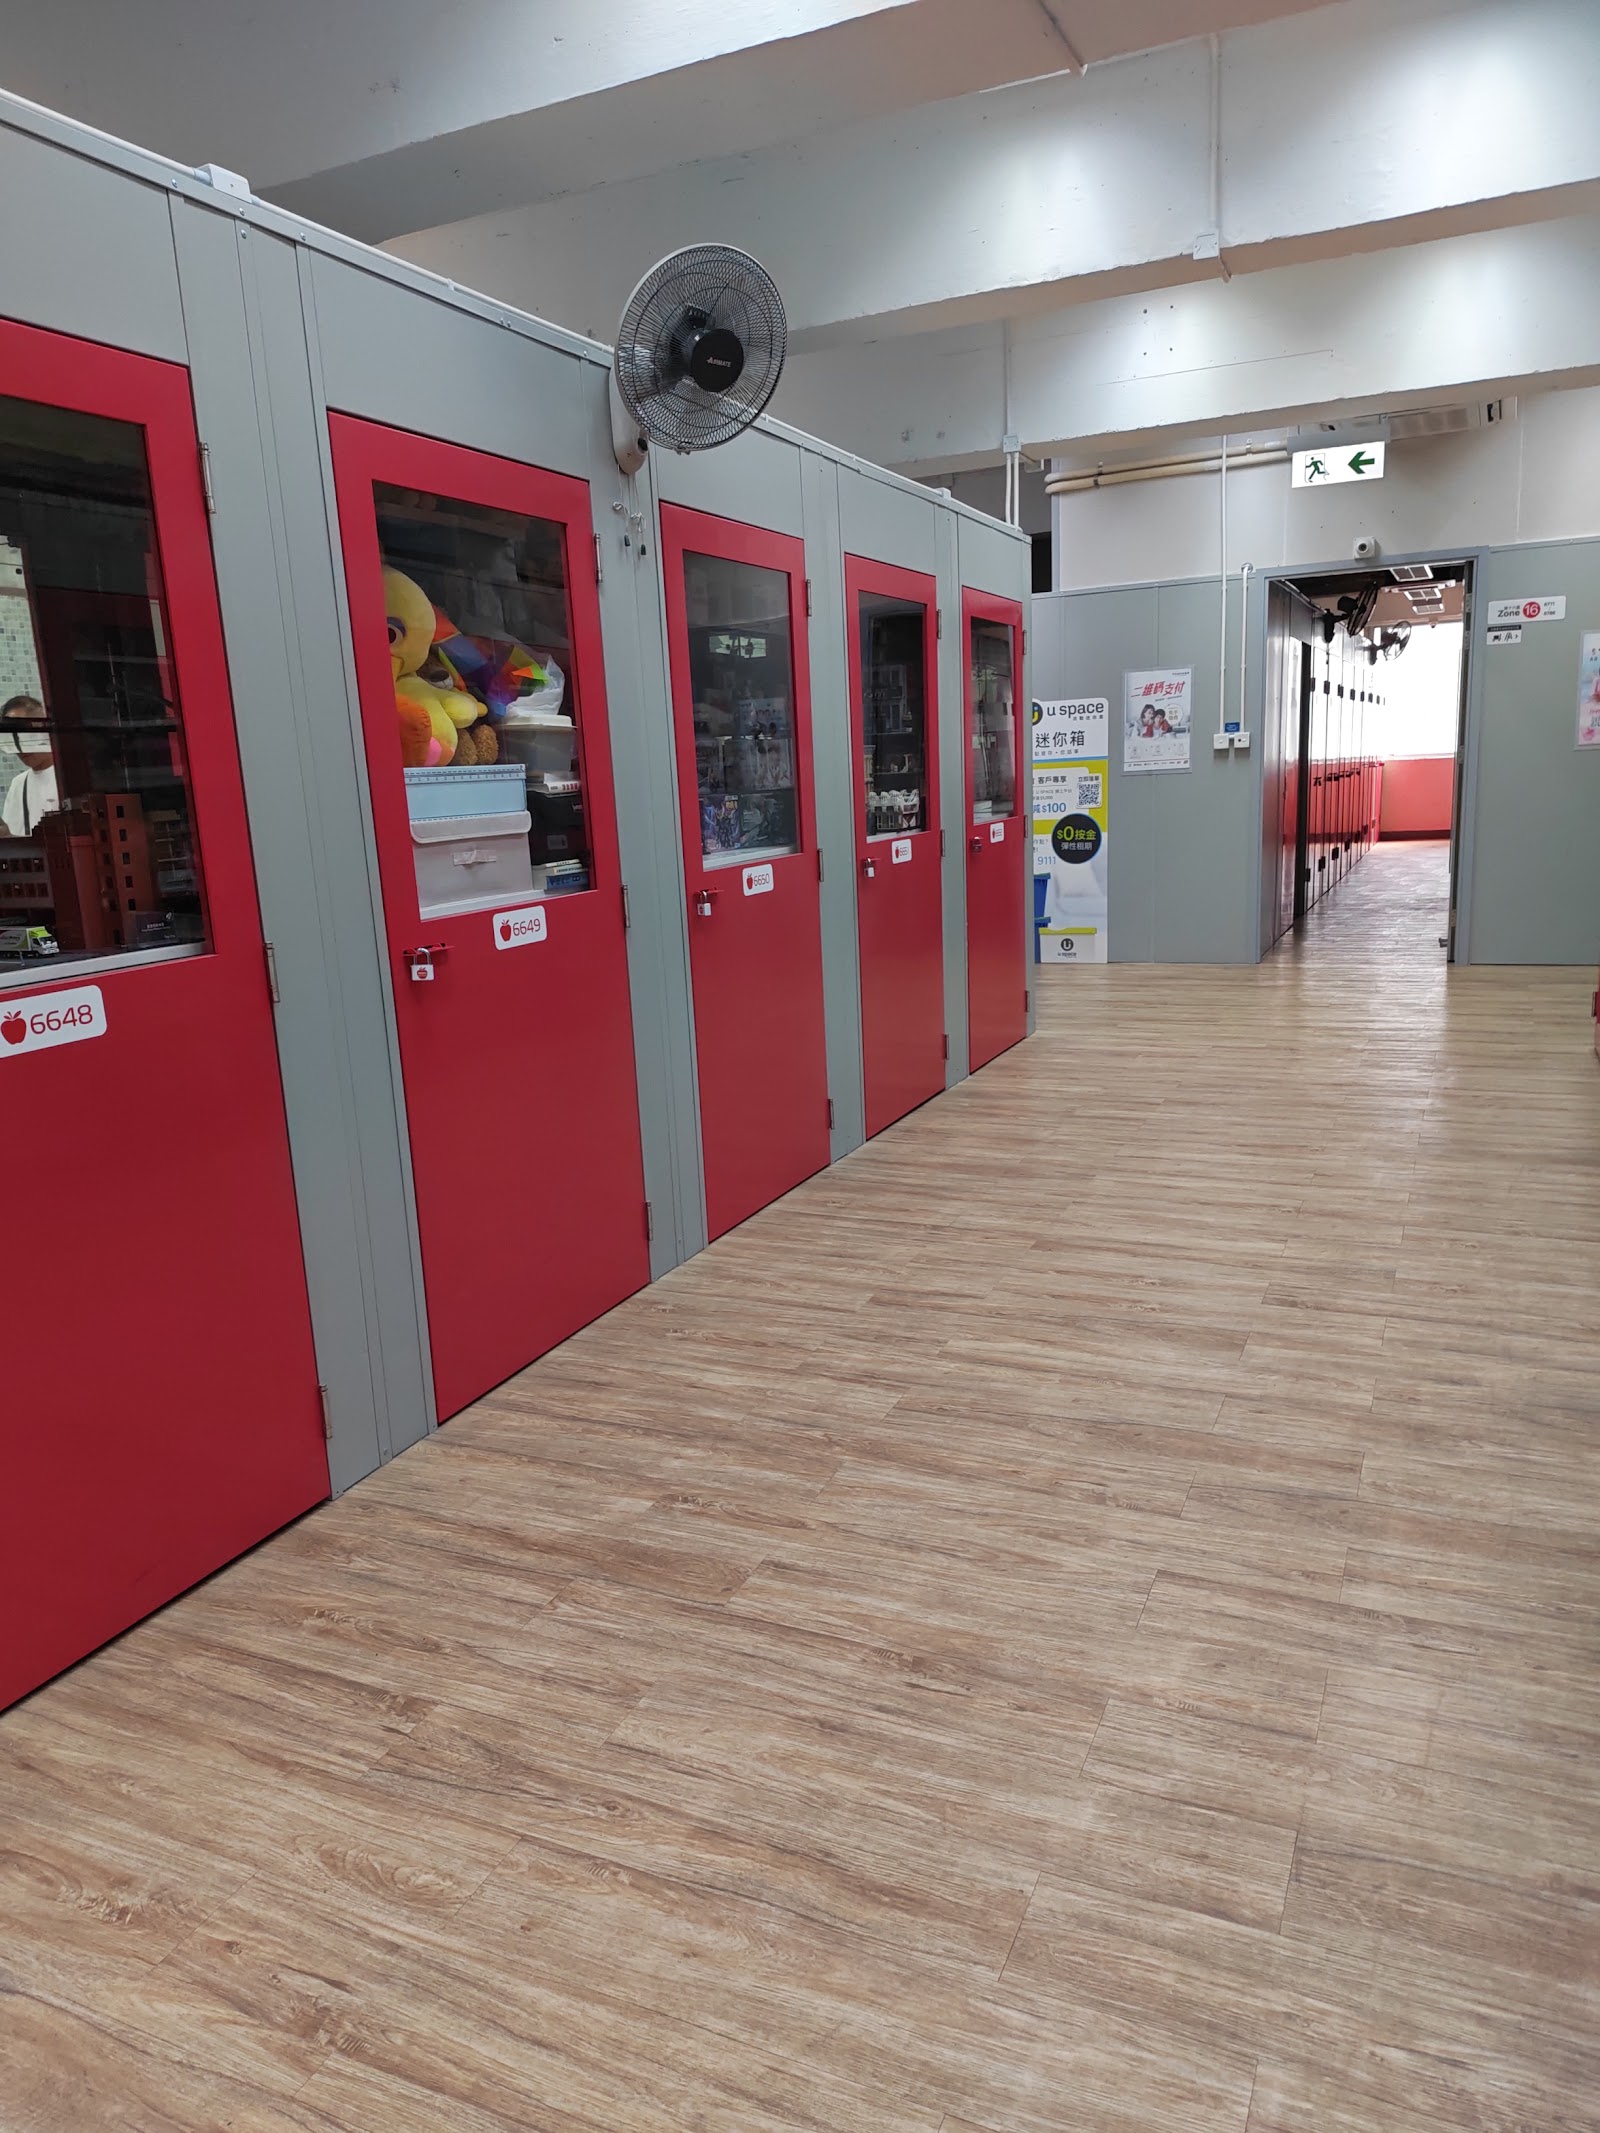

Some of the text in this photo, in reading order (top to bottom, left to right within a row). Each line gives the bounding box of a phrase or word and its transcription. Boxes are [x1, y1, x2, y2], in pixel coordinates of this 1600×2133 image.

[1497, 603, 1539, 618] Zone 16
[1047, 702, 1104, 718] u space
[1035, 730, 1085, 748] 迷你箱
[754, 873, 770, 886] 6650
[513, 918, 541, 936] 6649
[30, 1004, 93, 1034] 6648
